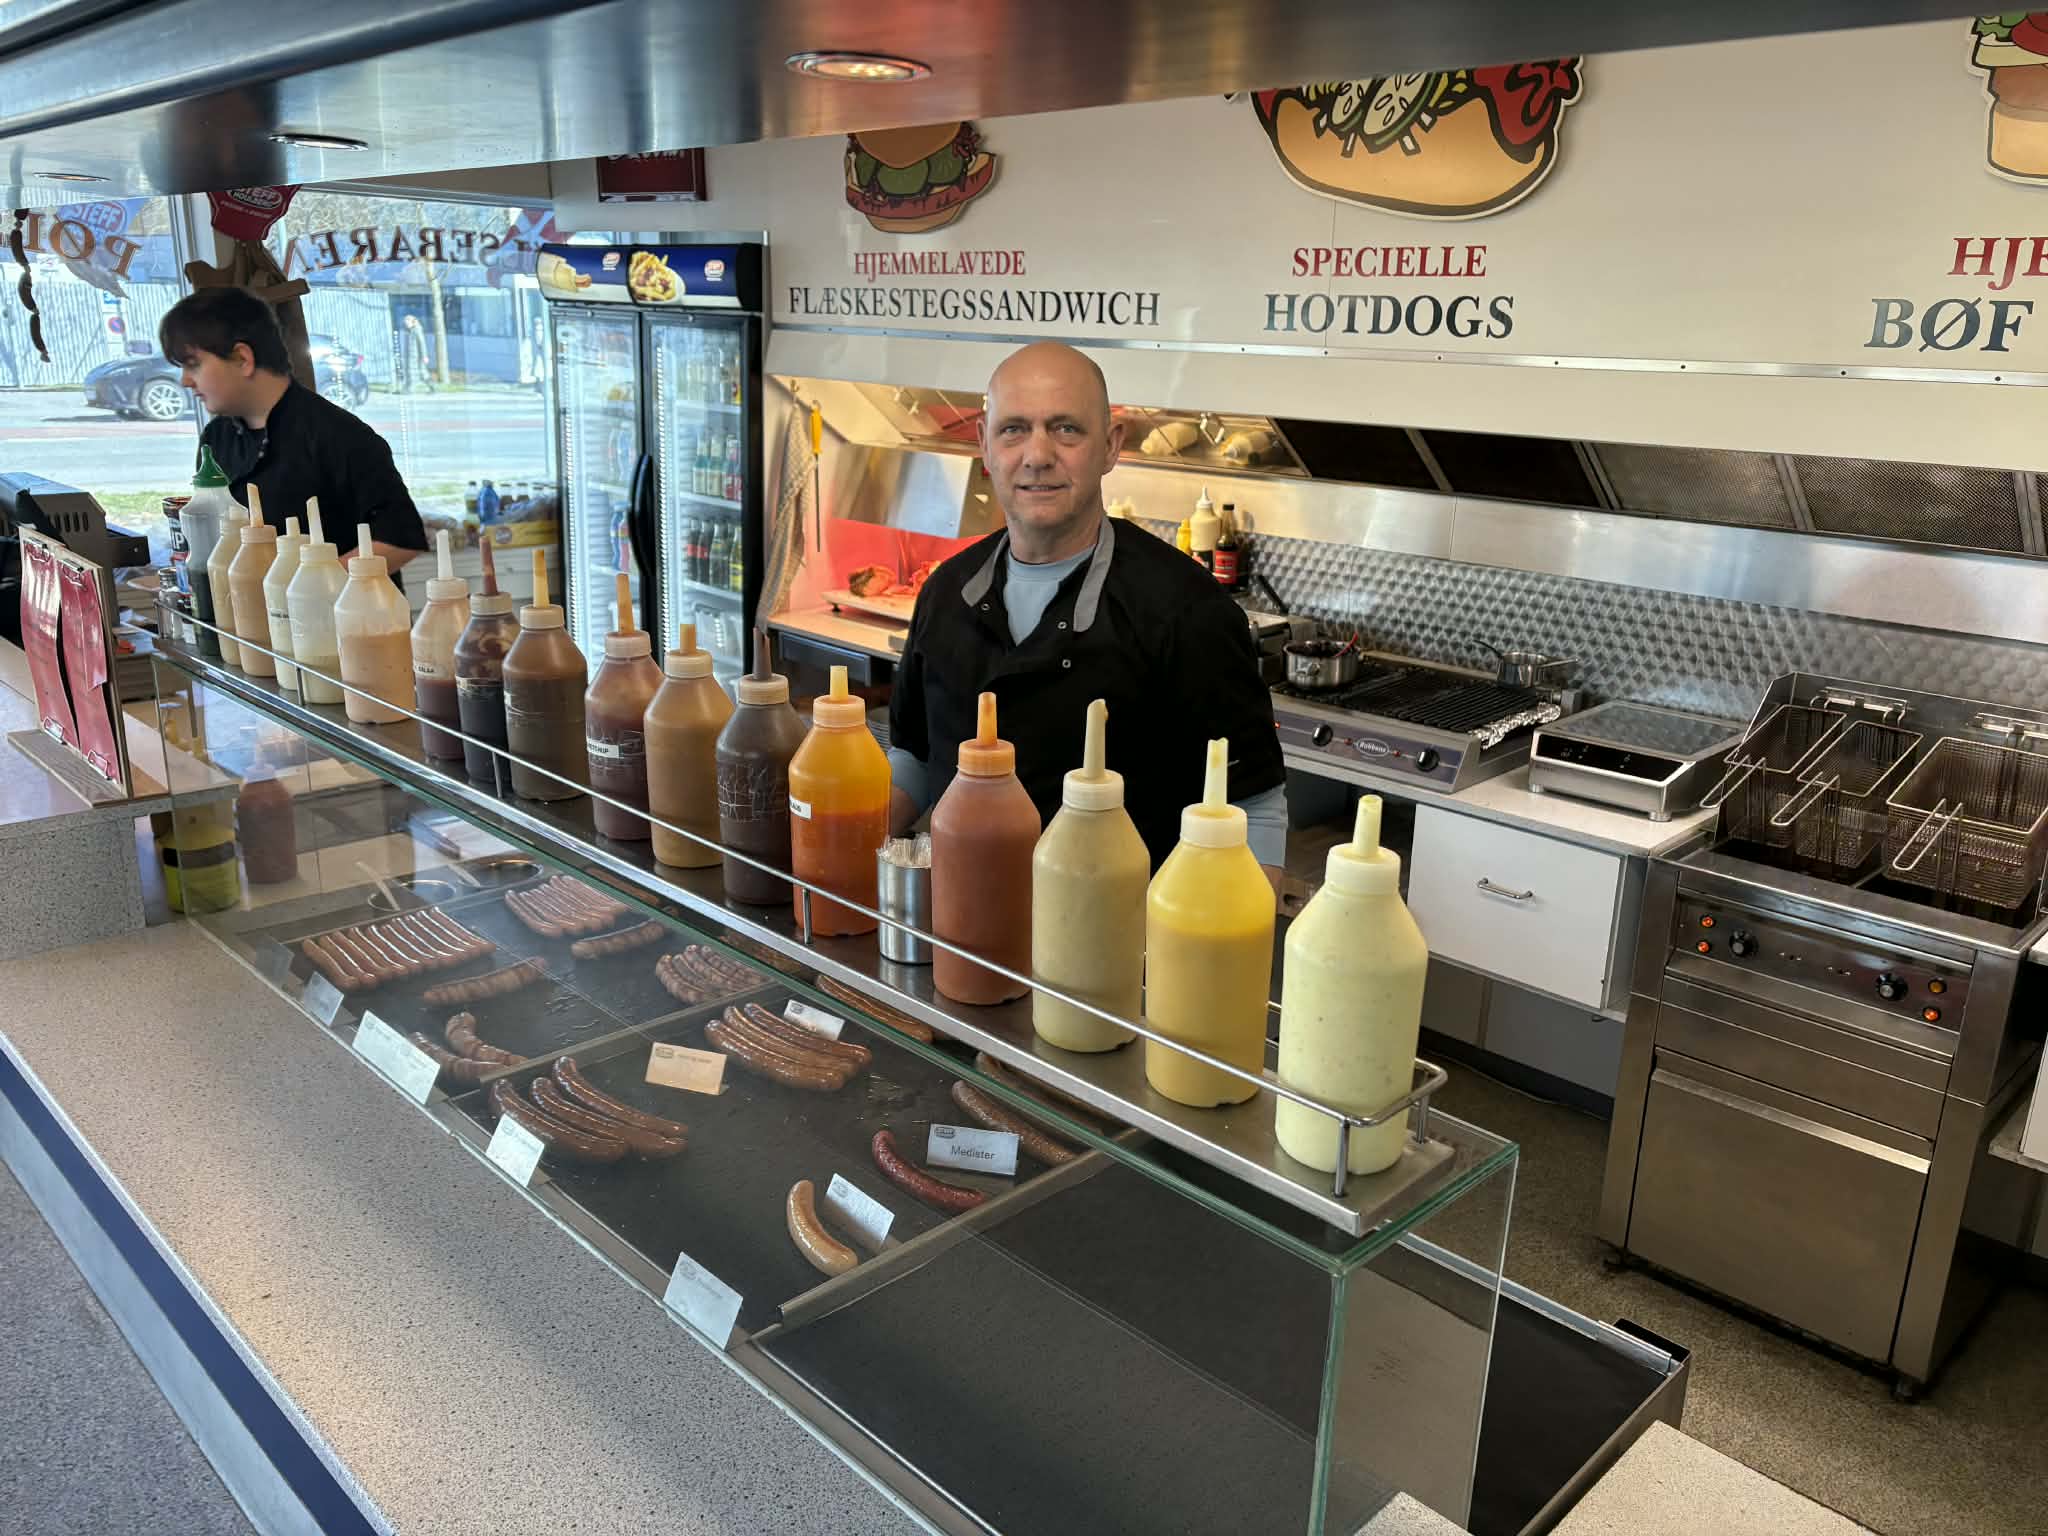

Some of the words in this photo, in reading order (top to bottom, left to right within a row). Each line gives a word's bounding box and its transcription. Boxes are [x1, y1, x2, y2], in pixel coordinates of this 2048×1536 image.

[854, 250, 1026, 282] HJEMMELAVEDE
[1292, 245, 1487, 277] SPECIELLE
[789, 287, 1161, 327] FLÆSKESTEGSSANDWICH
[1264, 293, 1514, 339] HOTDOGS
[1863, 297, 2035, 352] BØF
[951, 1144, 996, 1160] Medister
